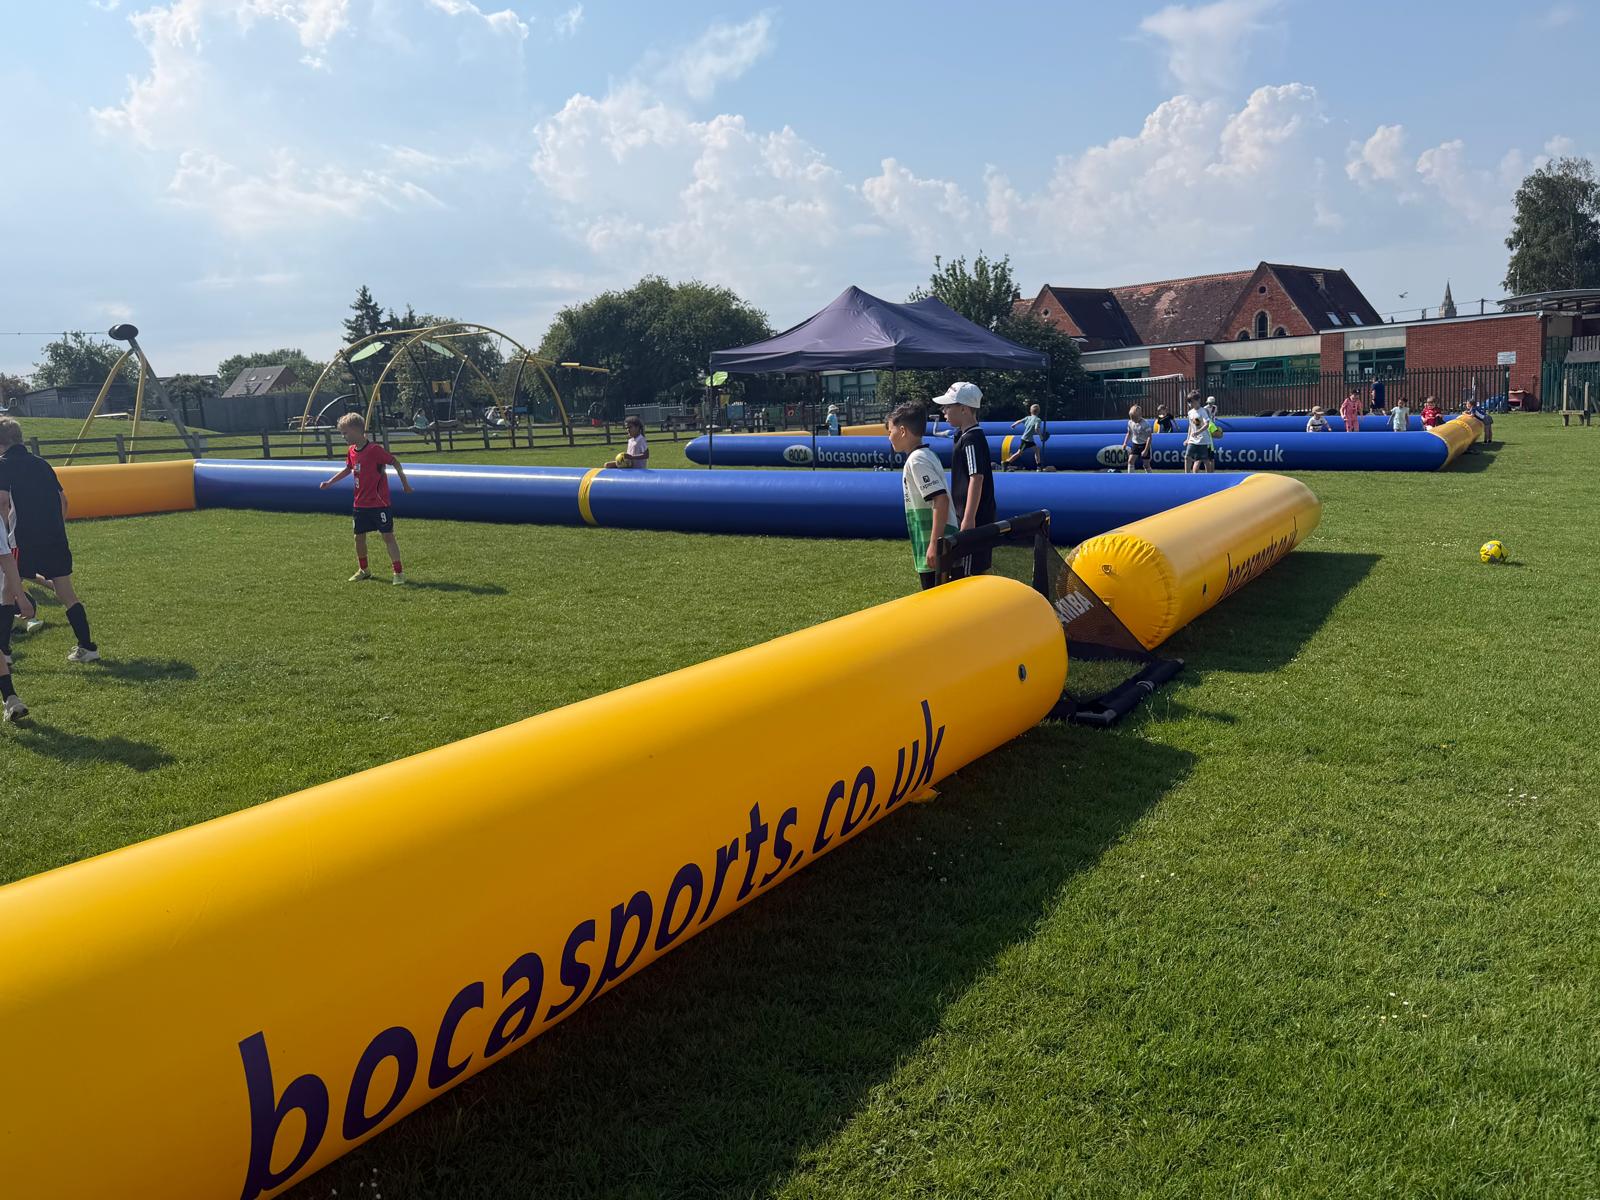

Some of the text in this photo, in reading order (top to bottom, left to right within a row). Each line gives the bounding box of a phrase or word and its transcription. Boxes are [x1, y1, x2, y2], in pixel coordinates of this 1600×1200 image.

[380, 512, 387, 522] 9
[1054, 590, 1095, 624] AMBA
[238, 699, 946, 1200] bocasports.co.uk
